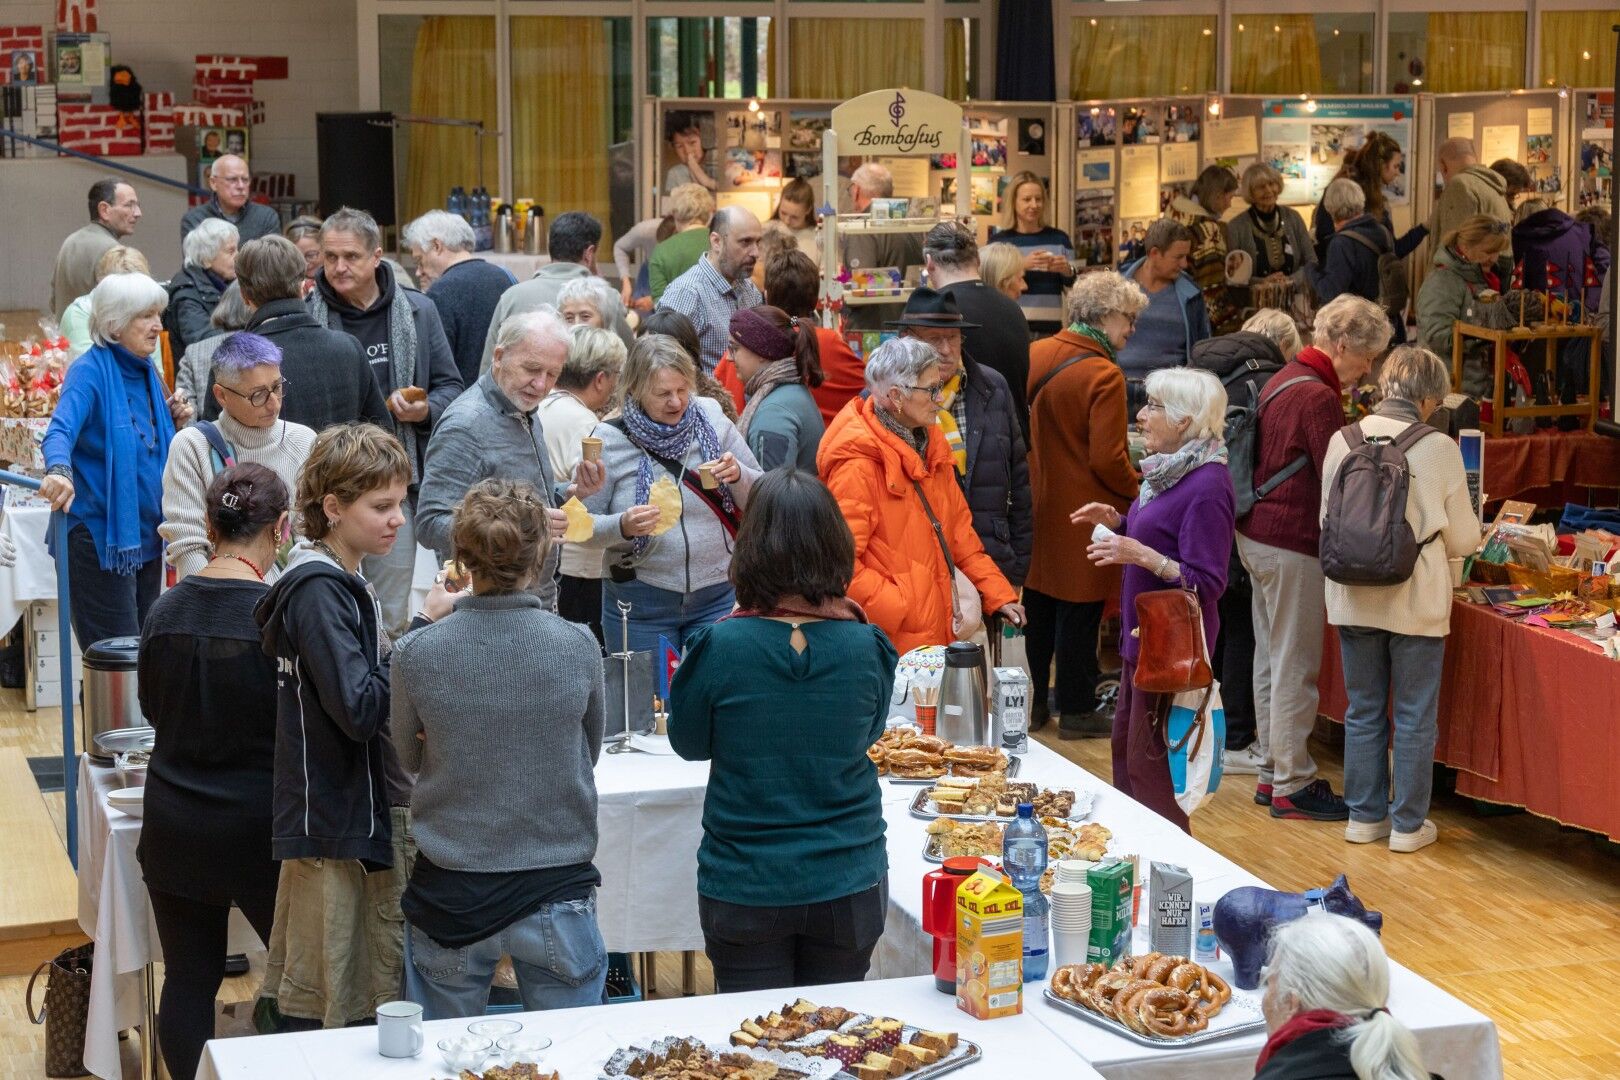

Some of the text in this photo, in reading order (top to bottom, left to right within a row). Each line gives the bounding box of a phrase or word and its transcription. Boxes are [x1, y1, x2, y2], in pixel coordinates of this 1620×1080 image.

[1005, 696, 1025, 707] LY!
[1168, 893, 1183, 902] WIR
[1158, 901, 1191, 911] KENNEN
[1166, 909, 1183, 917] NUR
[1161, 917, 1187, 926] HAFER
